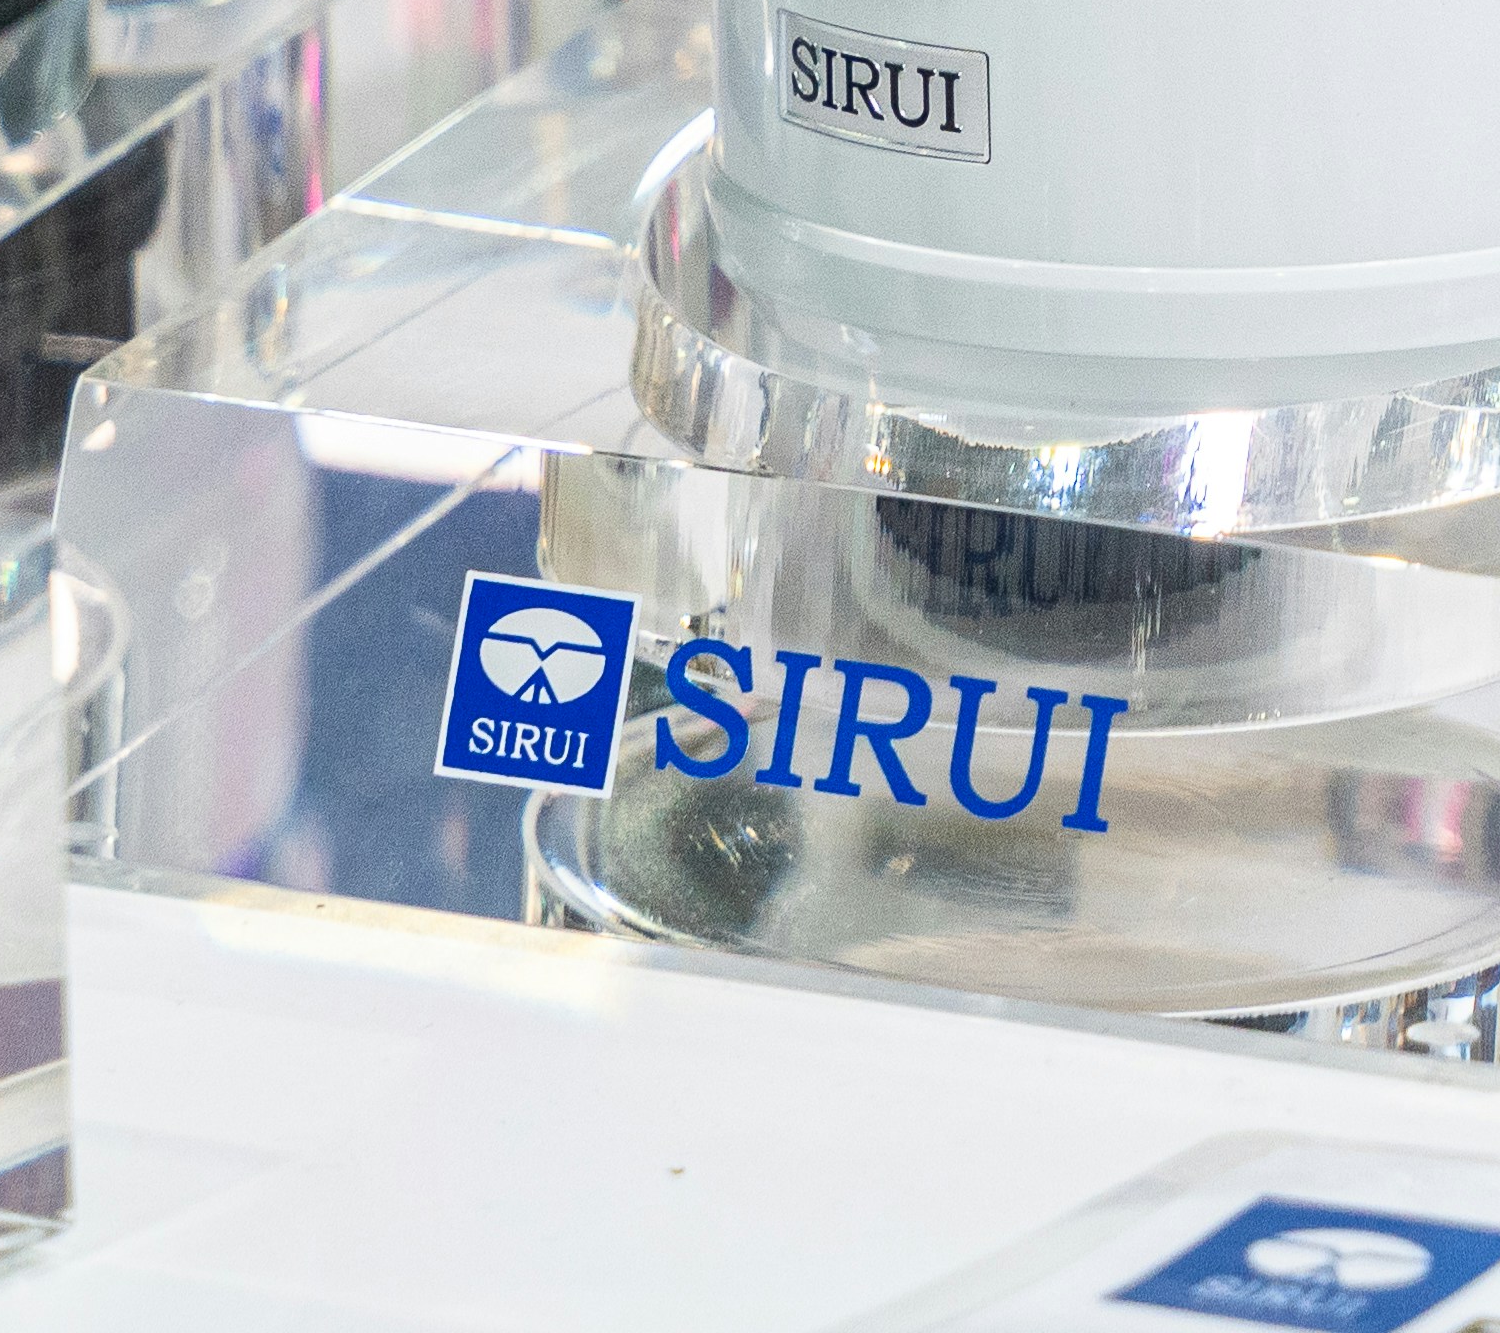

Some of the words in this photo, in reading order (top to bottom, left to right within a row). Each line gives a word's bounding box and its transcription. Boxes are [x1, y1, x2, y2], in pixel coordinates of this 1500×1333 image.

[790, 36, 963, 134] SIRUI
[467, 716, 592, 770] SIRUI
[654, 637, 1129, 834] SIRUI
